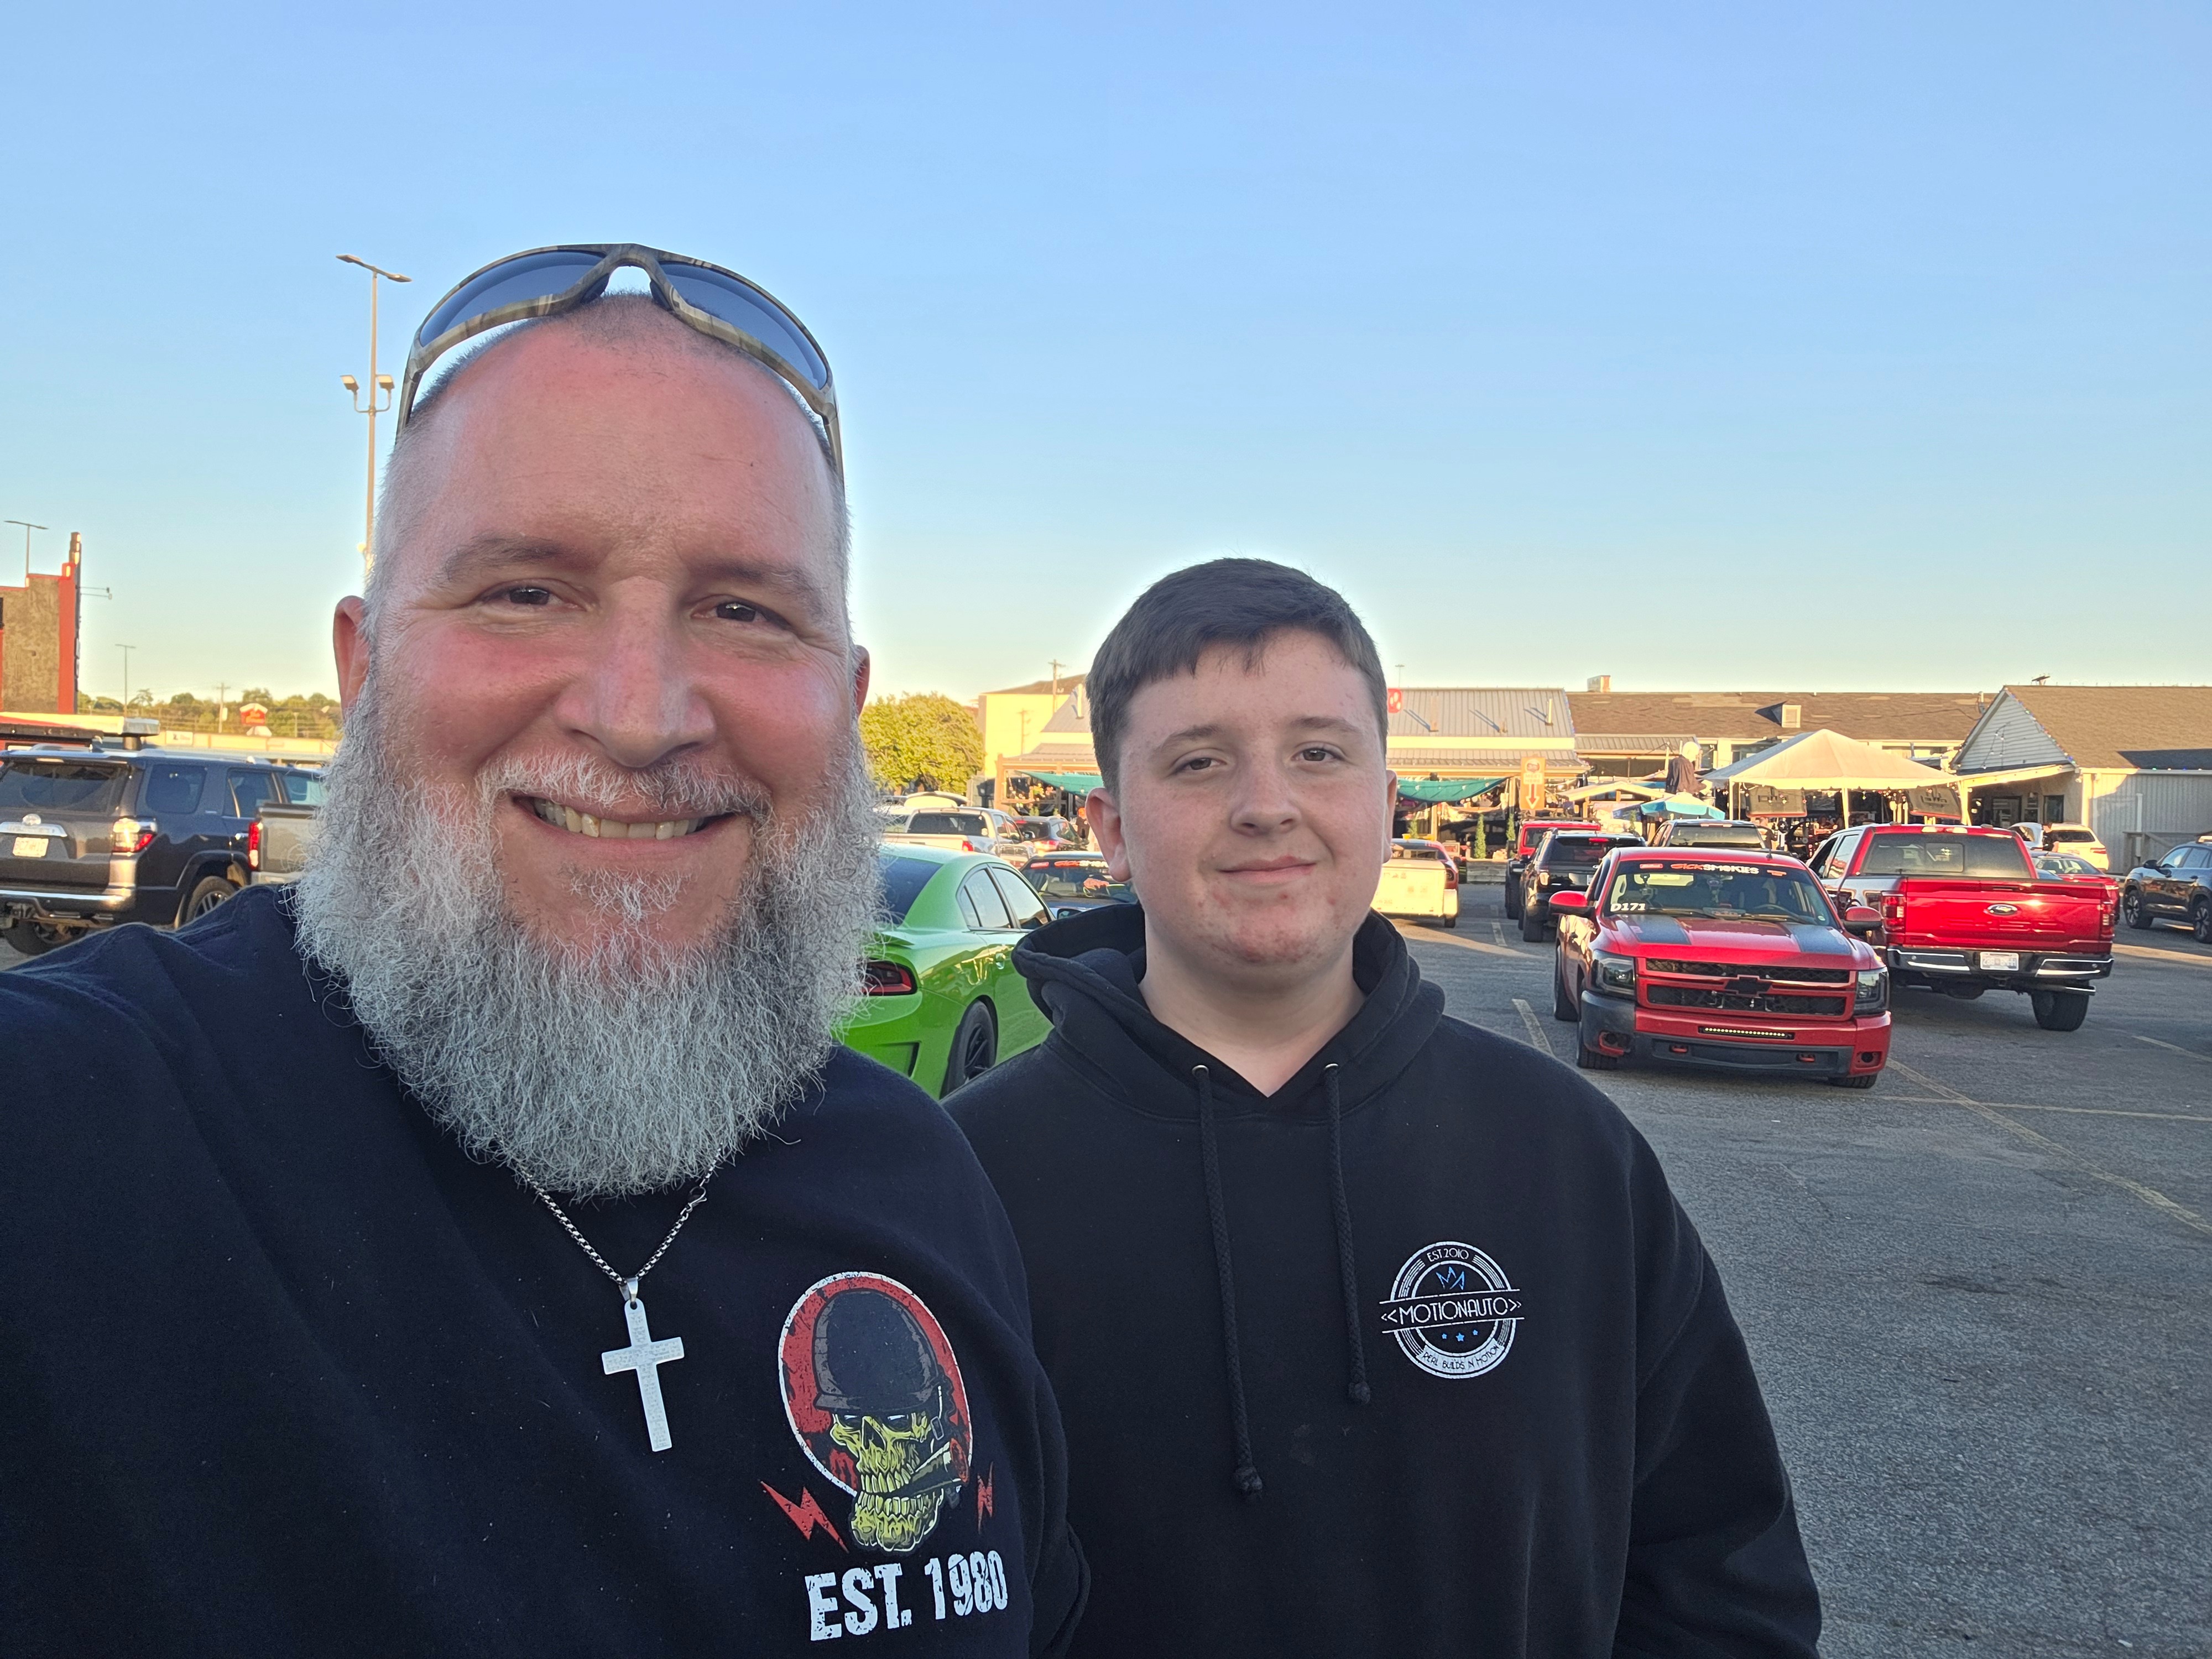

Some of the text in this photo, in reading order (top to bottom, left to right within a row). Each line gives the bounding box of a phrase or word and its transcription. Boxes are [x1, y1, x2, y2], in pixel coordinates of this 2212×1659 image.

[1610, 902, 1646, 912] D171
[1426, 1248, 1469, 1262] EST.2010
[1399, 1297, 1509, 1325] MOTIONAUTO
[1423, 1352, 1438, 1366] REAL
[1442, 1360, 1465, 1370] BUILDS
[1476, 1344, 1500, 1366] MOTION
[805, 1550, 1008, 1641] EST. 1980
